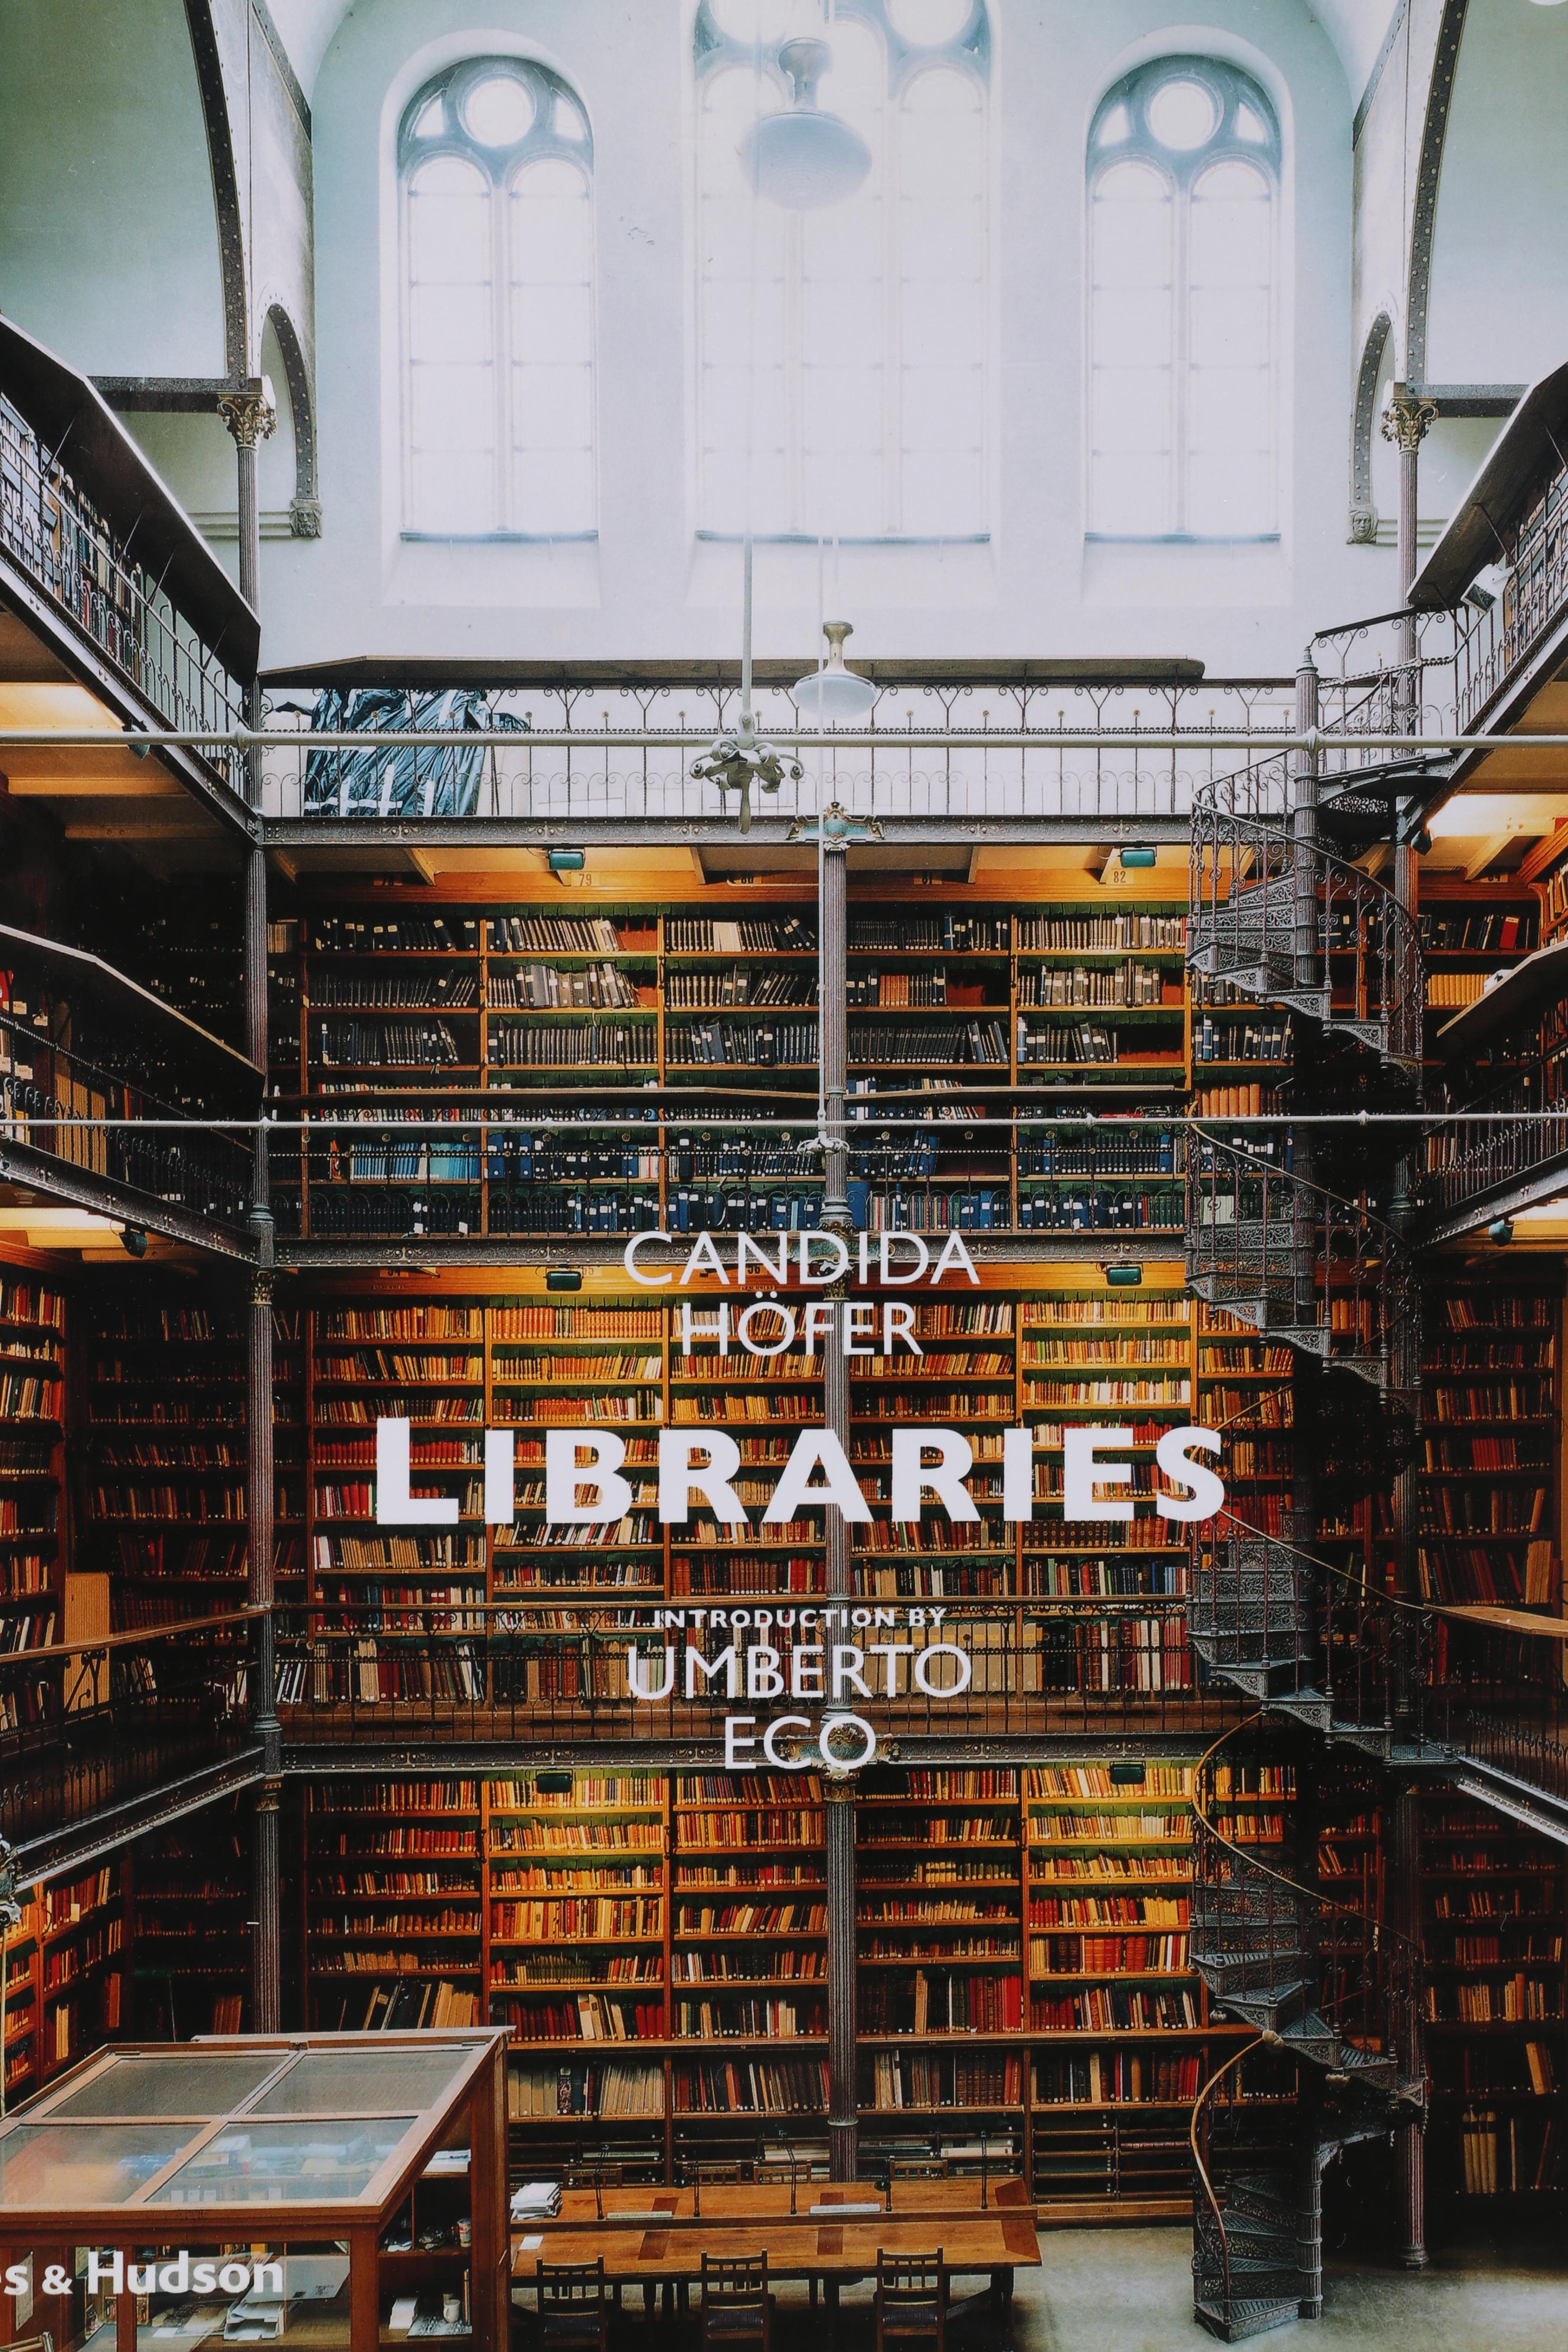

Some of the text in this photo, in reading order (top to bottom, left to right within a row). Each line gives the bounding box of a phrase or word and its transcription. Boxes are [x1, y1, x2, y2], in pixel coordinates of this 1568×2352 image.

[579, 874, 592, 886] 79
[1113, 871, 1126, 884] 82
[623, 1230, 980, 1285] CANDIDA
[681, 1291, 924, 1356] HÖFER
[375, 1416, 1225, 1525] LIBRARIES
[652, 1607, 946, 1629] INTRODUCTION BY
[628, 1644, 971, 1700] UMBERTO
[724, 1715, 876, 1770] ECO
[0, 2250, 283, 2295] s & Hudson
